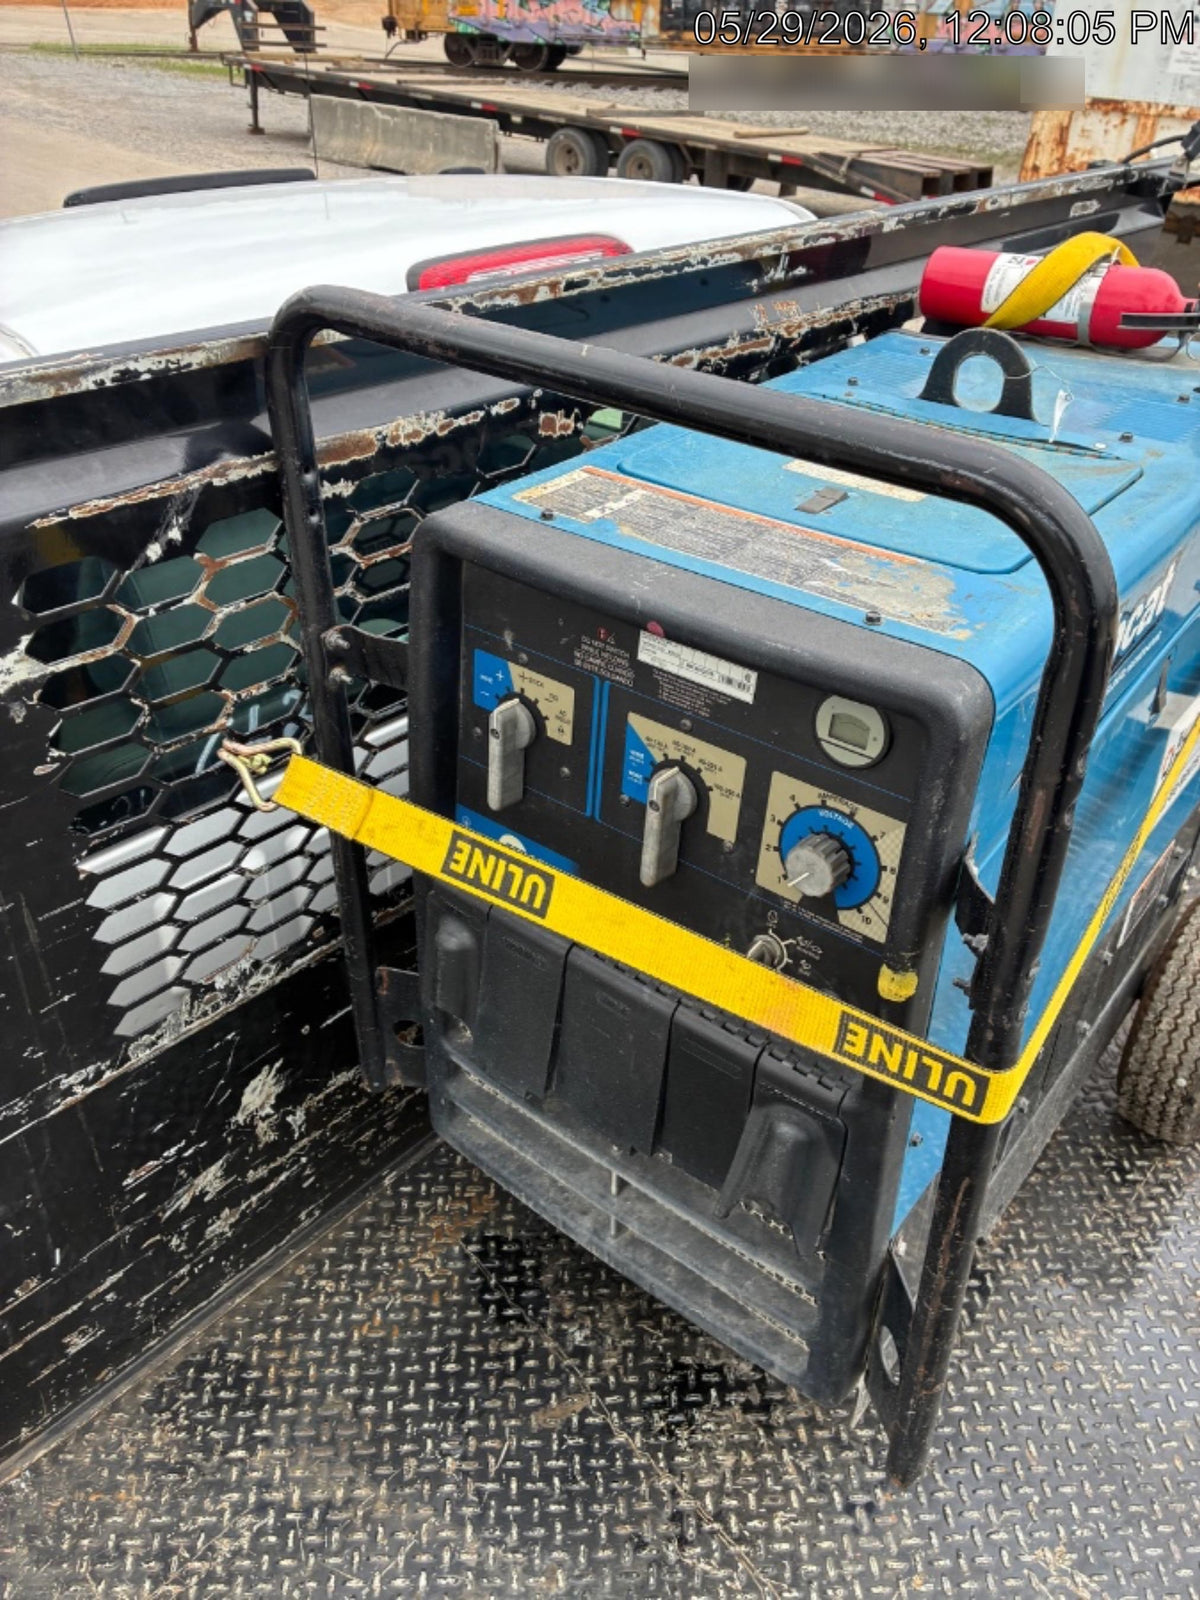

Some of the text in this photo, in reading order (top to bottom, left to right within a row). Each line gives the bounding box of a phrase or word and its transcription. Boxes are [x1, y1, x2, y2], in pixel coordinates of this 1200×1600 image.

[449, 840, 546, 909] ULINE
[861, 914, 872, 925] 10
[843, 1021, 977, 1107] ULINE
